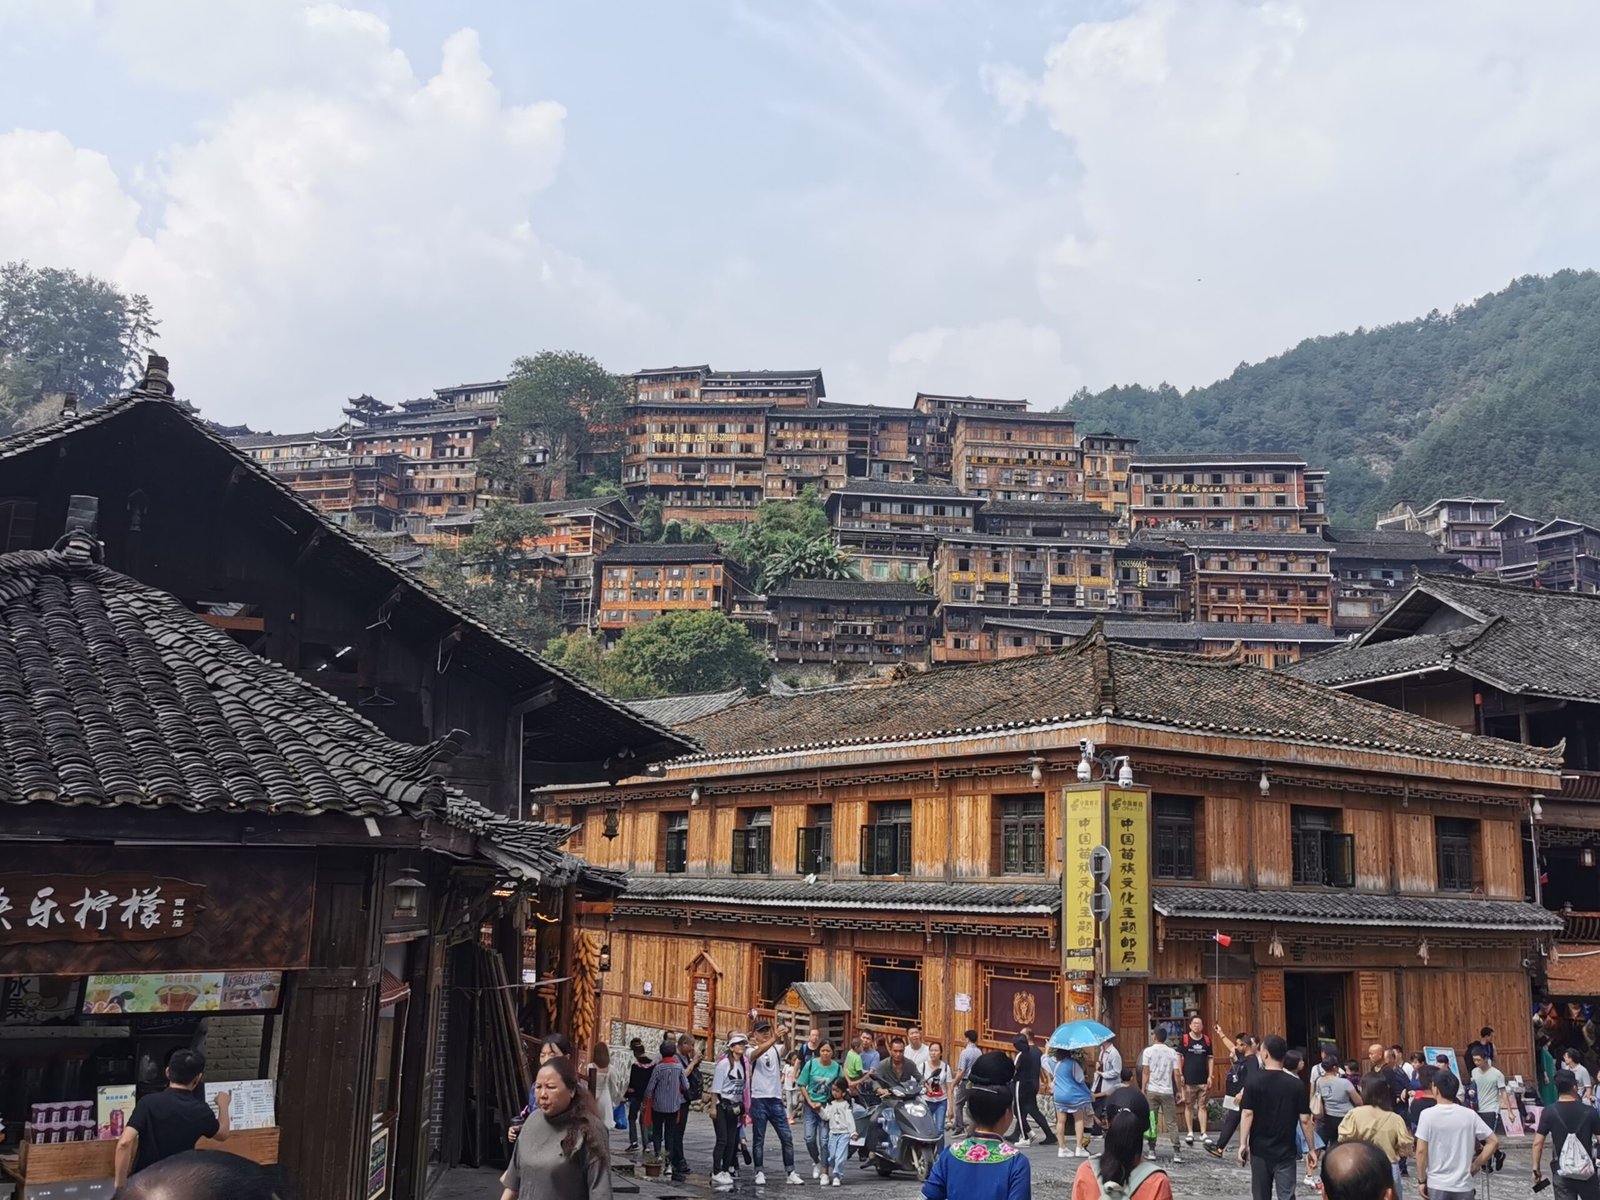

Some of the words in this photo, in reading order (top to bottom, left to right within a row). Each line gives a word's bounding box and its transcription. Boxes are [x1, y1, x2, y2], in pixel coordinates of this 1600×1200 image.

[1118, 817, 1138, 965] 中国苗族文化主题邮局
